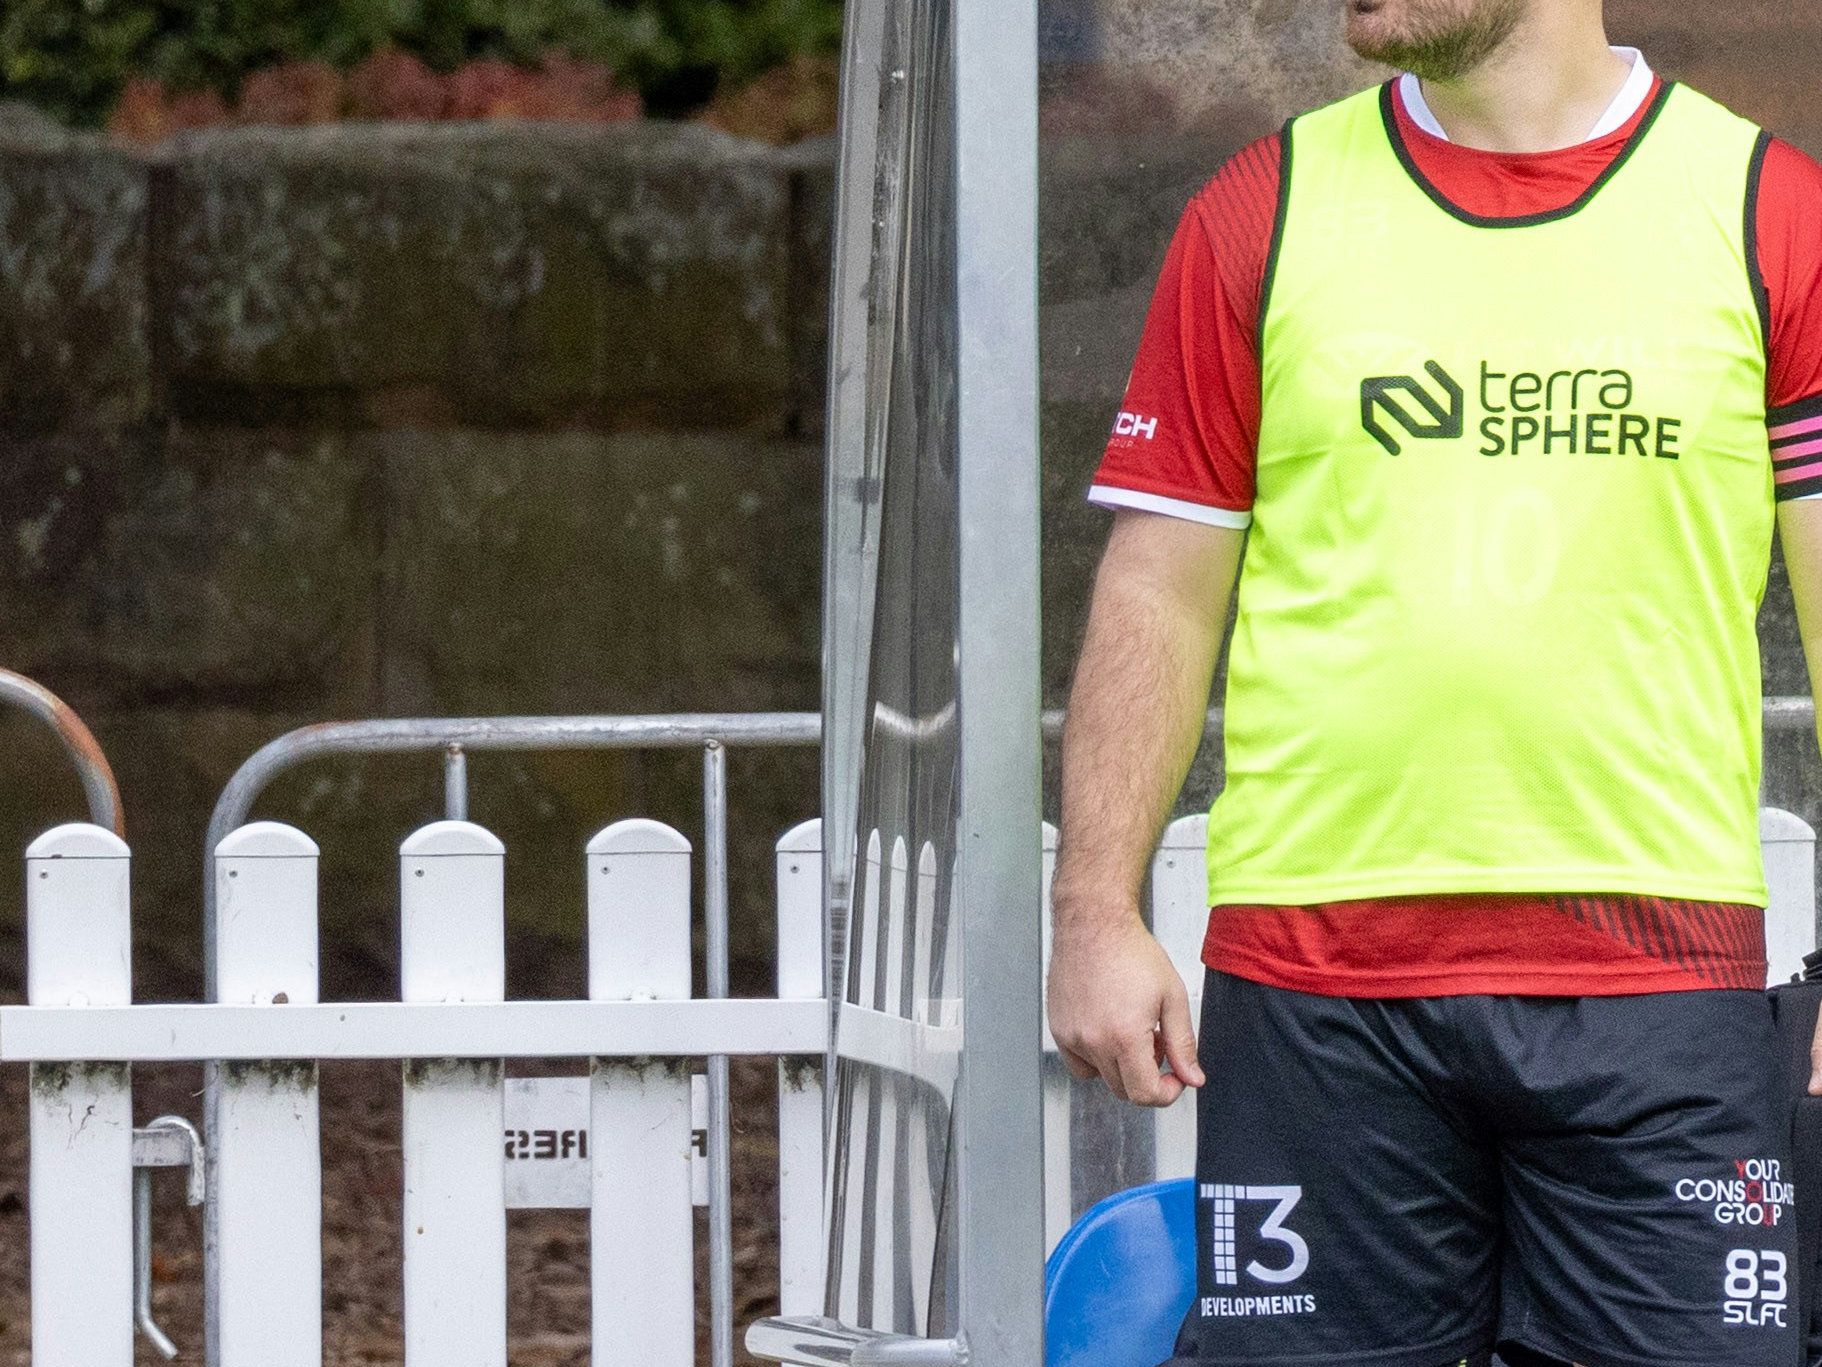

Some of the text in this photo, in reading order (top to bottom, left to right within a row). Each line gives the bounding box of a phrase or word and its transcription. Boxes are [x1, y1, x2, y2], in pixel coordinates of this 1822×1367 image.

[1481, 360, 1633, 413] terra
[1479, 412, 1681, 460] SPHERE
[1735, 1158, 1780, 1181] YOUR
[1200, 1183, 1310, 1285] T3
[1714, 1201, 1782, 1227] GROUP
[1724, 1249, 1787, 1301] 83
[1201, 1294, 1317, 1318] DEVELOPMENTS
